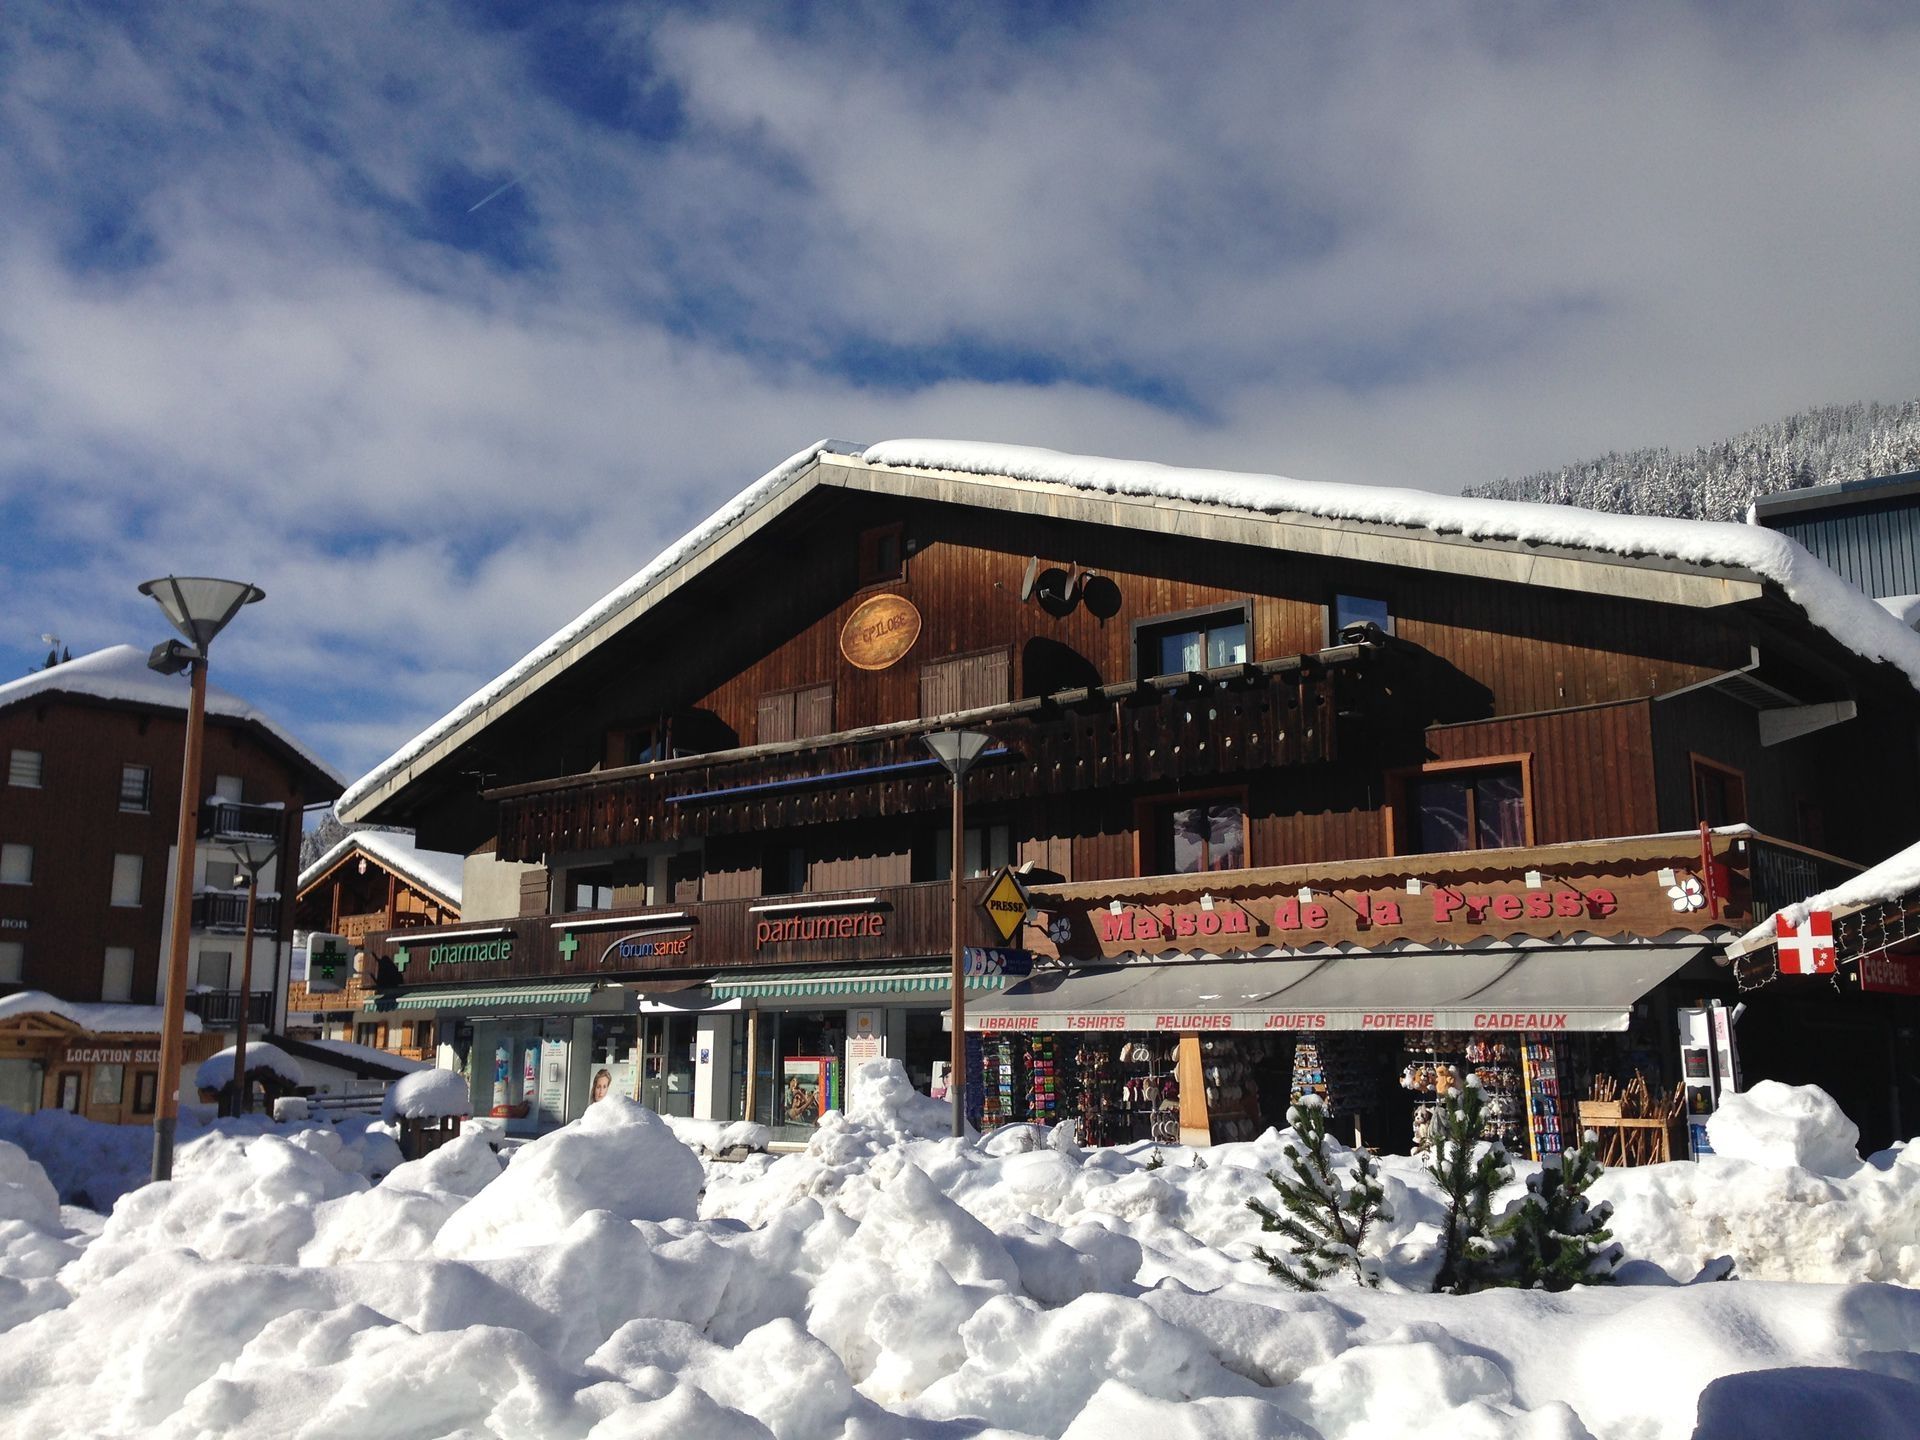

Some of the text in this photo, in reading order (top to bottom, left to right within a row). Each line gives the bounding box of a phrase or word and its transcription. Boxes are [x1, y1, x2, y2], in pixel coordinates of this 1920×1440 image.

[1706, 841, 1716, 900] TABAC
[990, 899, 1024, 913] PRESSE
[1103, 888, 1617, 941] Maison de la Presse
[756, 911, 884, 950] parfumerie
[429, 938, 512, 971] pharmacie
[979, 1013, 1568, 1030] LIBRAIRIE T-SHIRTS PELUCHES JOUETS POTERIE CADEAUX
[66, 1048, 132, 1063] LOCATION
